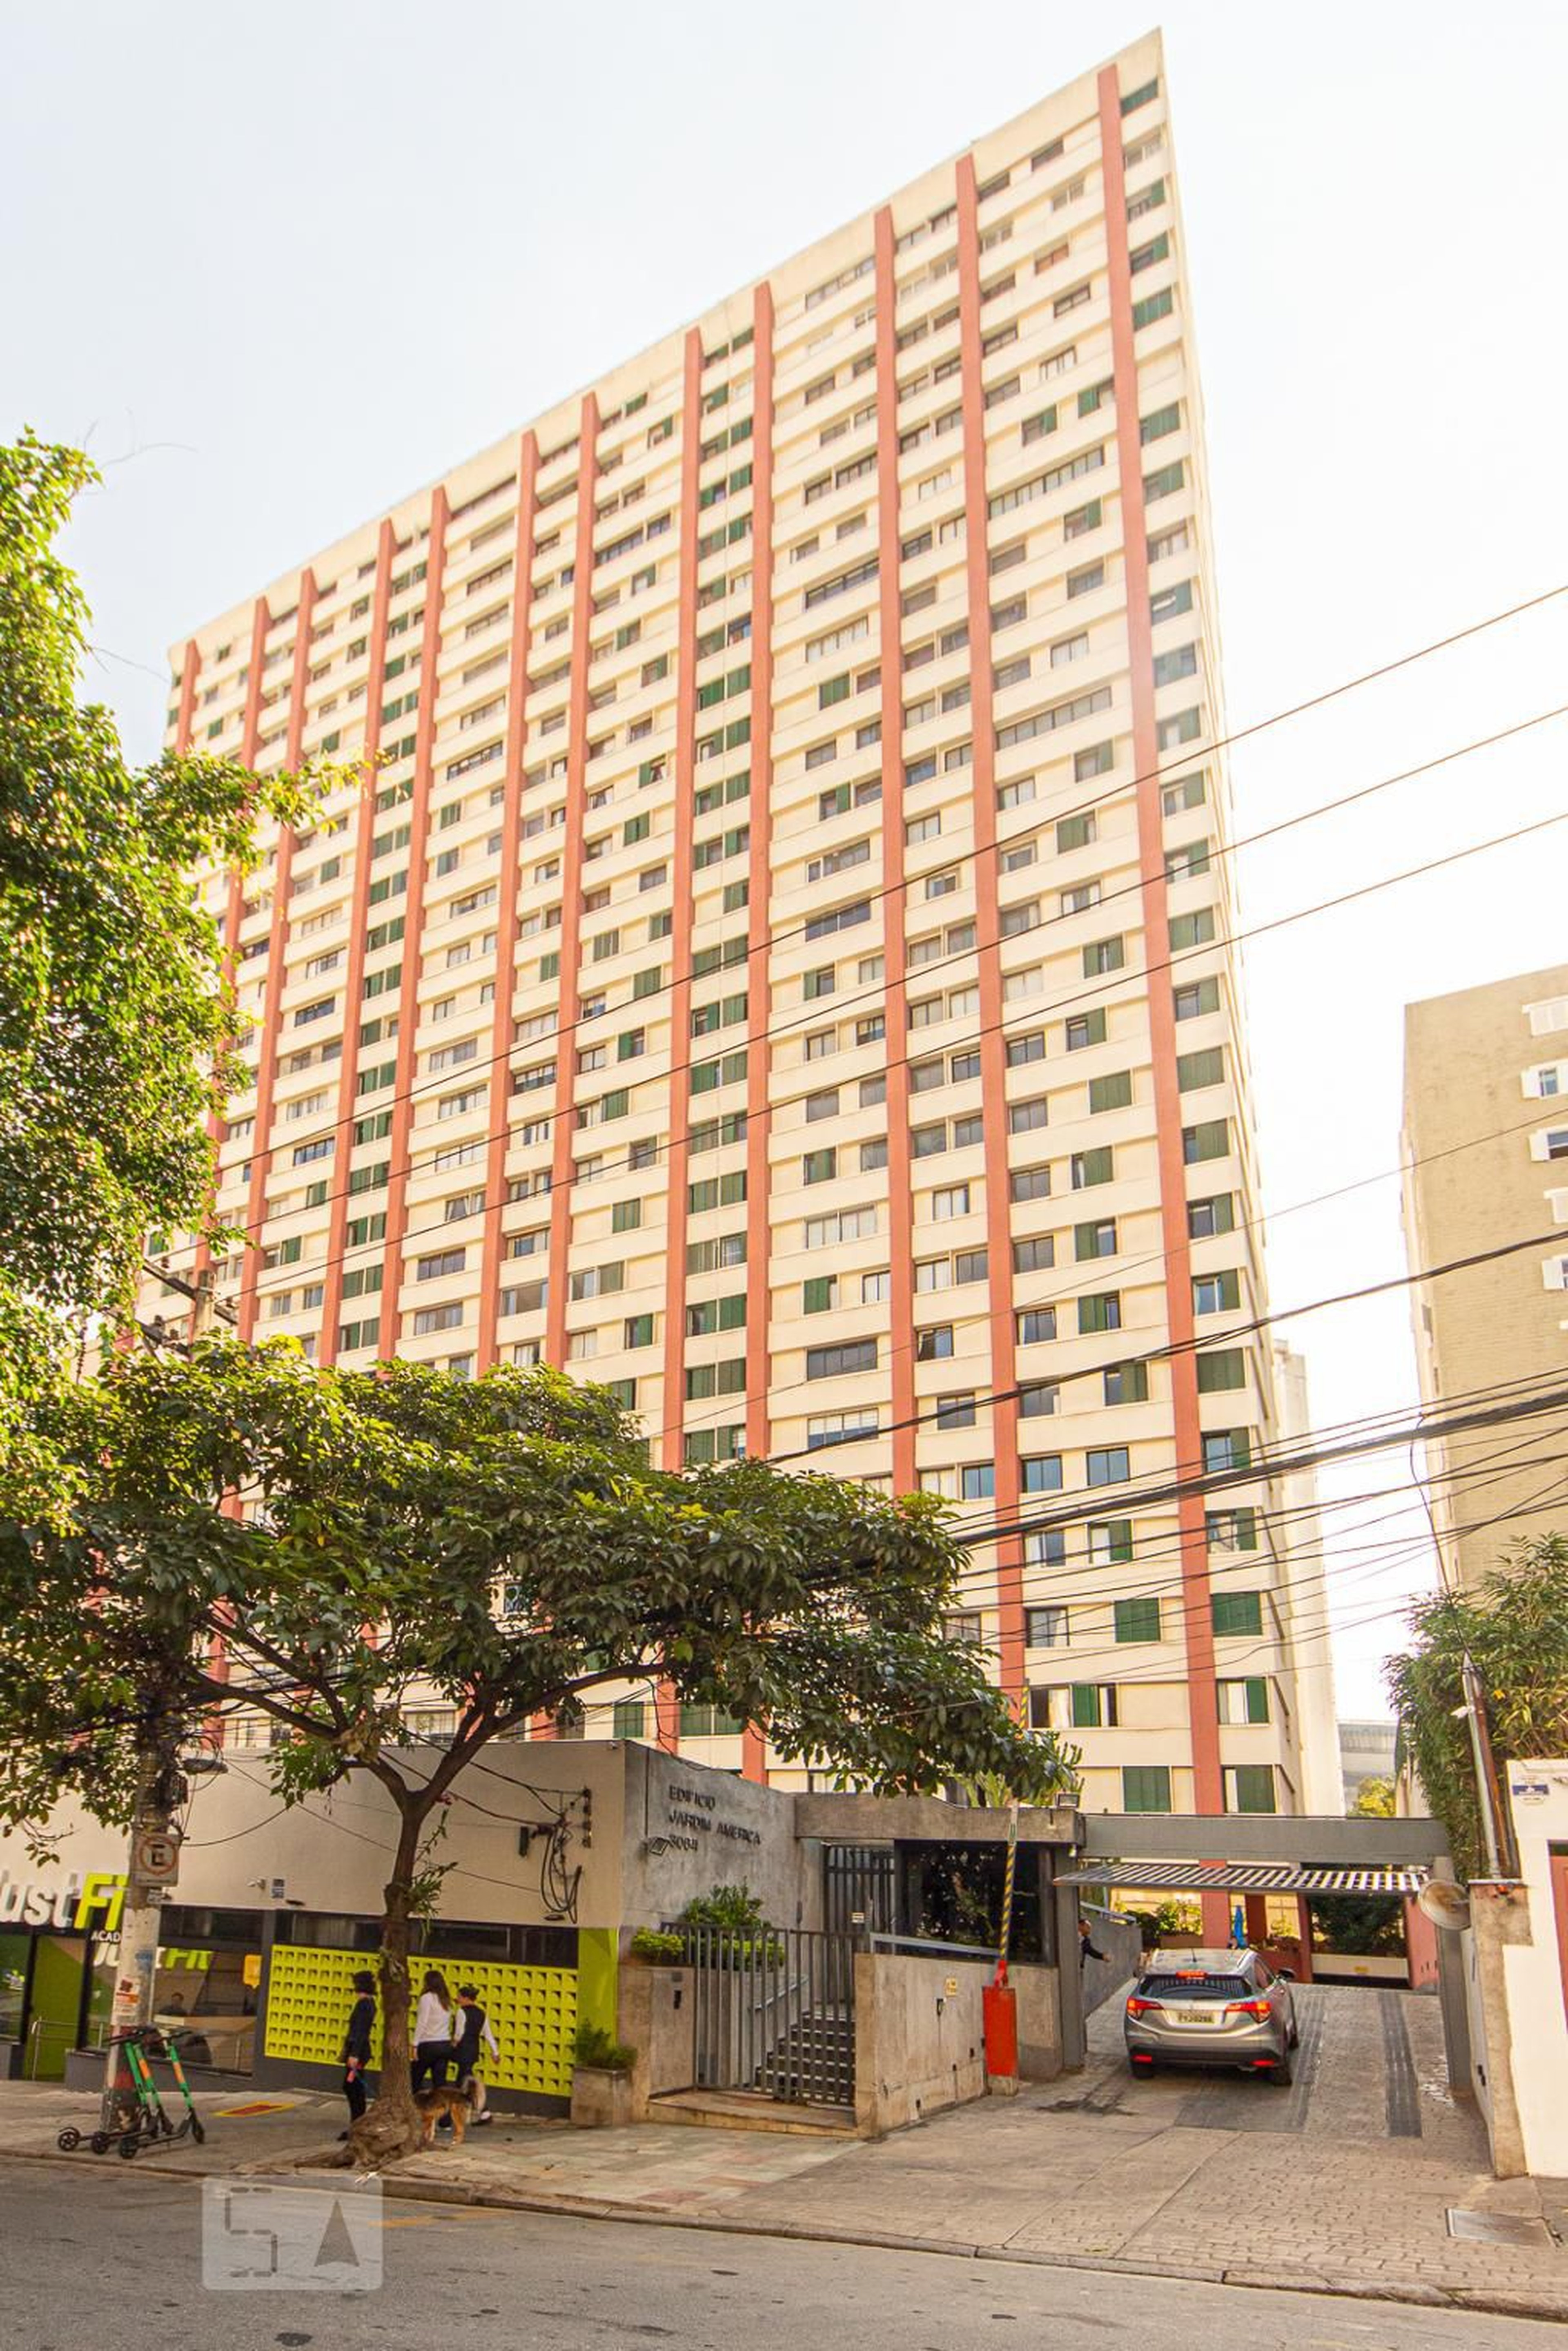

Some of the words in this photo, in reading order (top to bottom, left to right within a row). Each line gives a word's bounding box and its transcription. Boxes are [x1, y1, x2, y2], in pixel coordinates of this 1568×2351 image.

[668, 1809, 711, 1831] JARDIM
[0, 1871, 129, 1931] ustFi
[91, 1931, 121, 1943] ACAD
